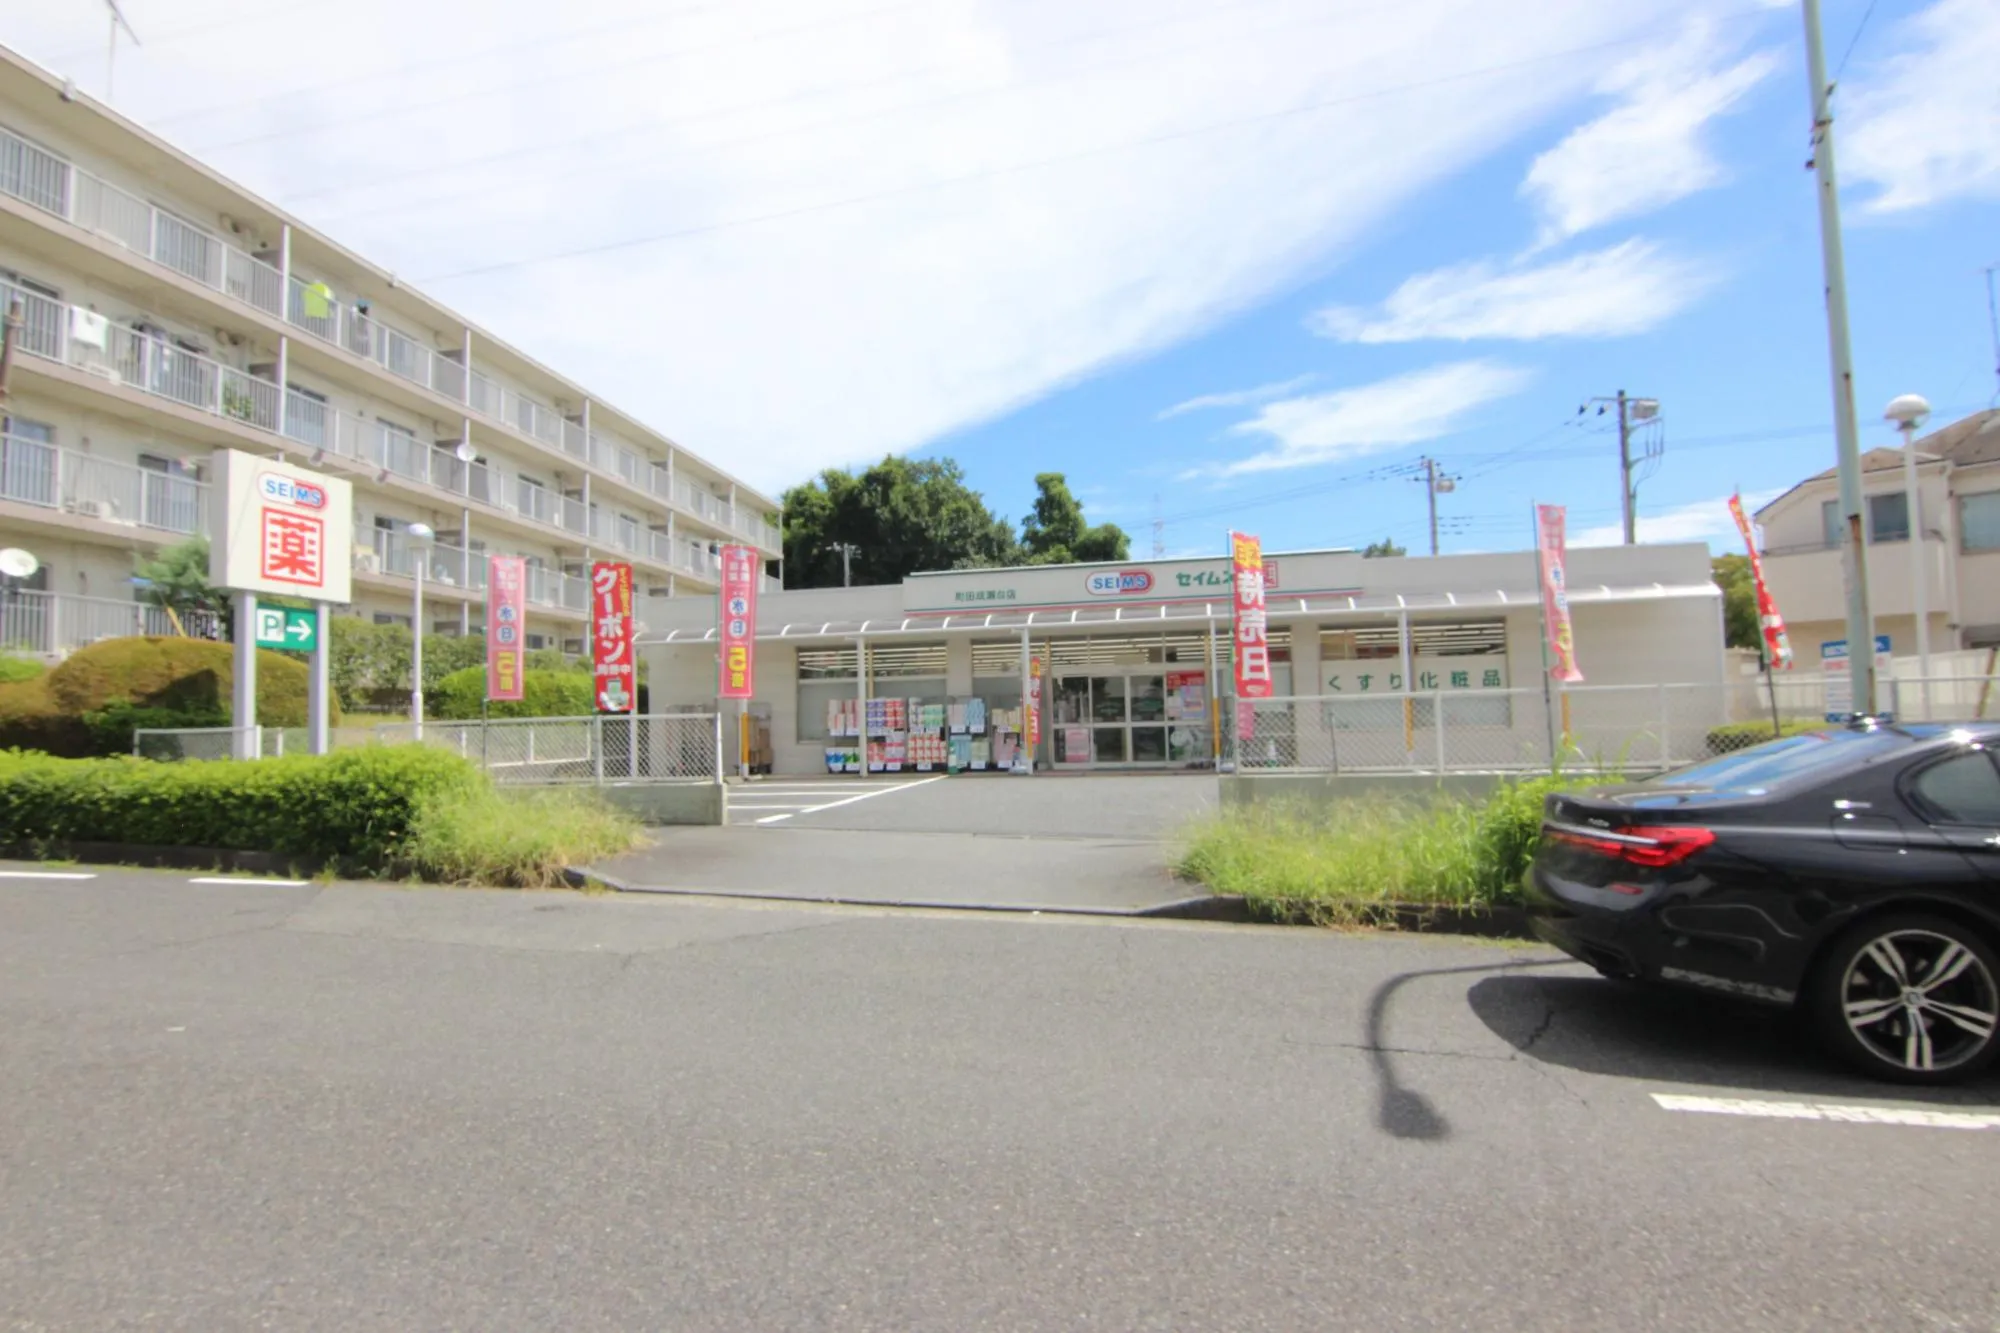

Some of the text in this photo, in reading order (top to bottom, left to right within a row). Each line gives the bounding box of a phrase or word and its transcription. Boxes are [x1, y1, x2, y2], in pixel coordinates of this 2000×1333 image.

[266, 479, 321, 505] SEIMS
[269, 517, 317, 577] 薬
[1092, 575, 1147, 591] SEIMS
[264, 614, 280, 638] P
[594, 567, 624, 663] クーポン
